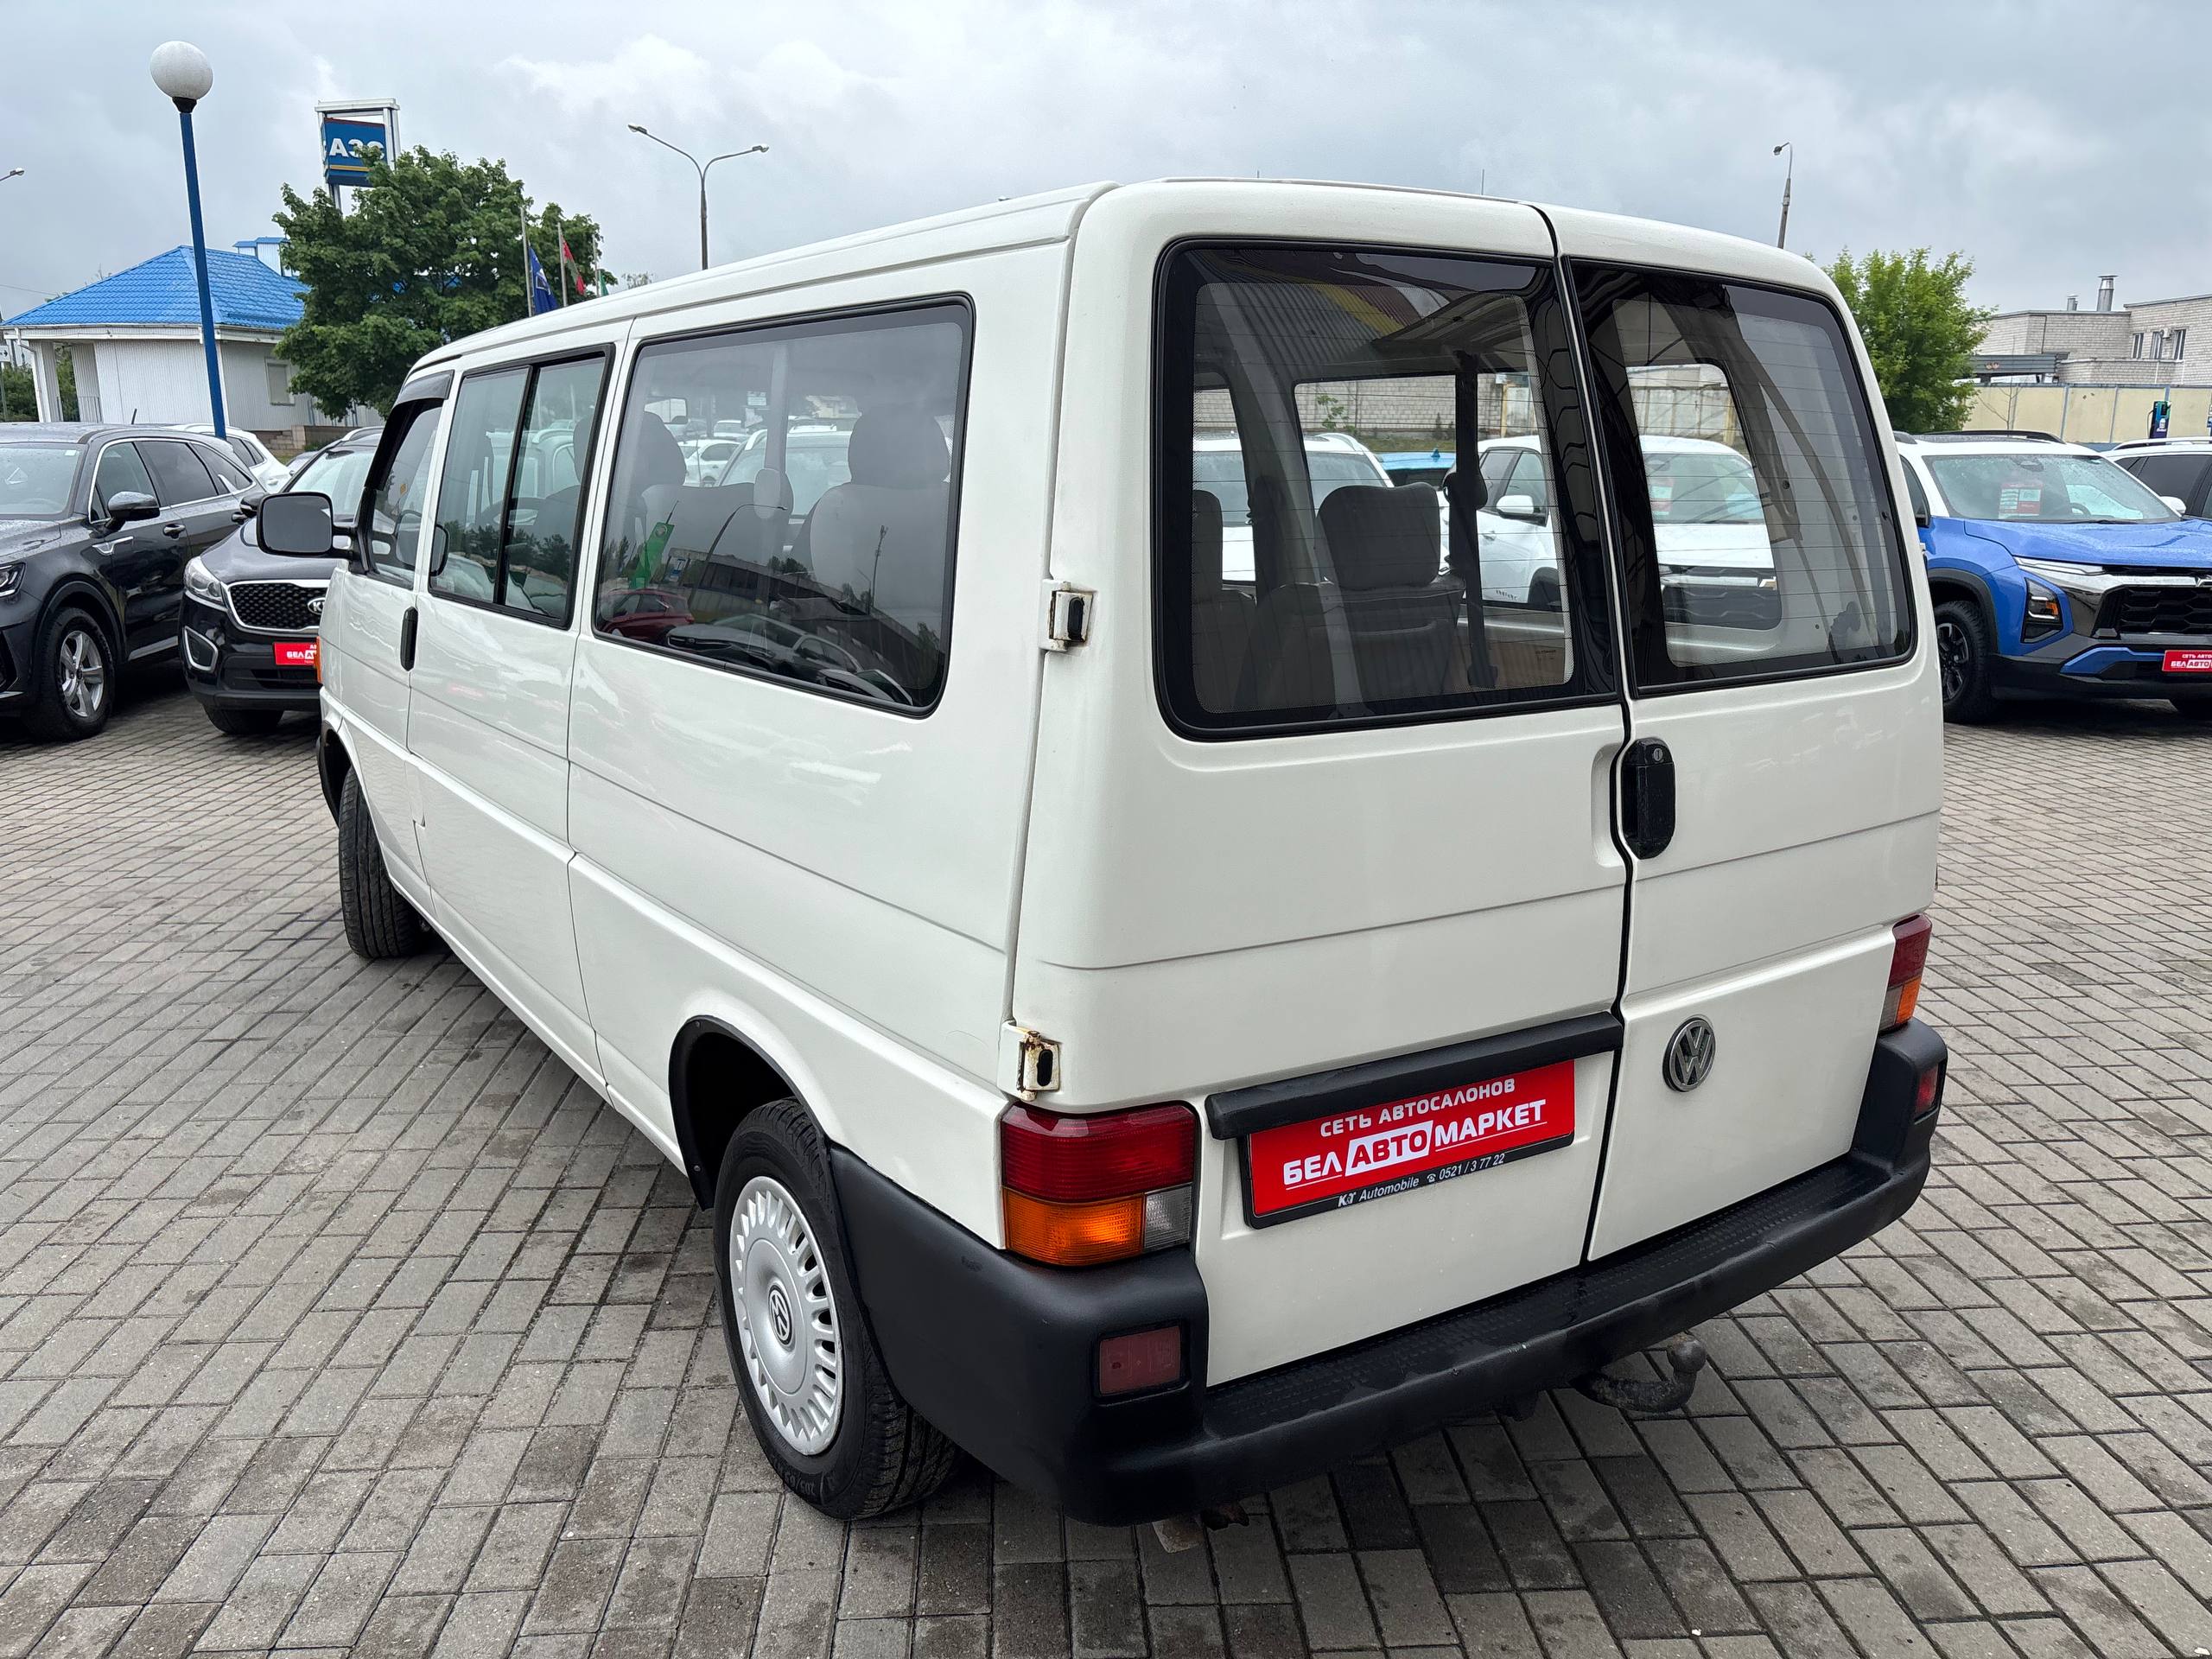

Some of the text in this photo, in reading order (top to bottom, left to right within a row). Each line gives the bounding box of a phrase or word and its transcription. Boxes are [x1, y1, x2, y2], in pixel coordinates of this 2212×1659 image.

[1320, 1077, 1516, 1138] СЕТЬ АВТОСАЛОНОВ
[1358, 1176, 1420, 1202] Automobile
[1439, 1165, 1463, 1180] 0521
[1479, 1156, 1492, 1169] 77
[1492, 1153, 1506, 1166] 22
